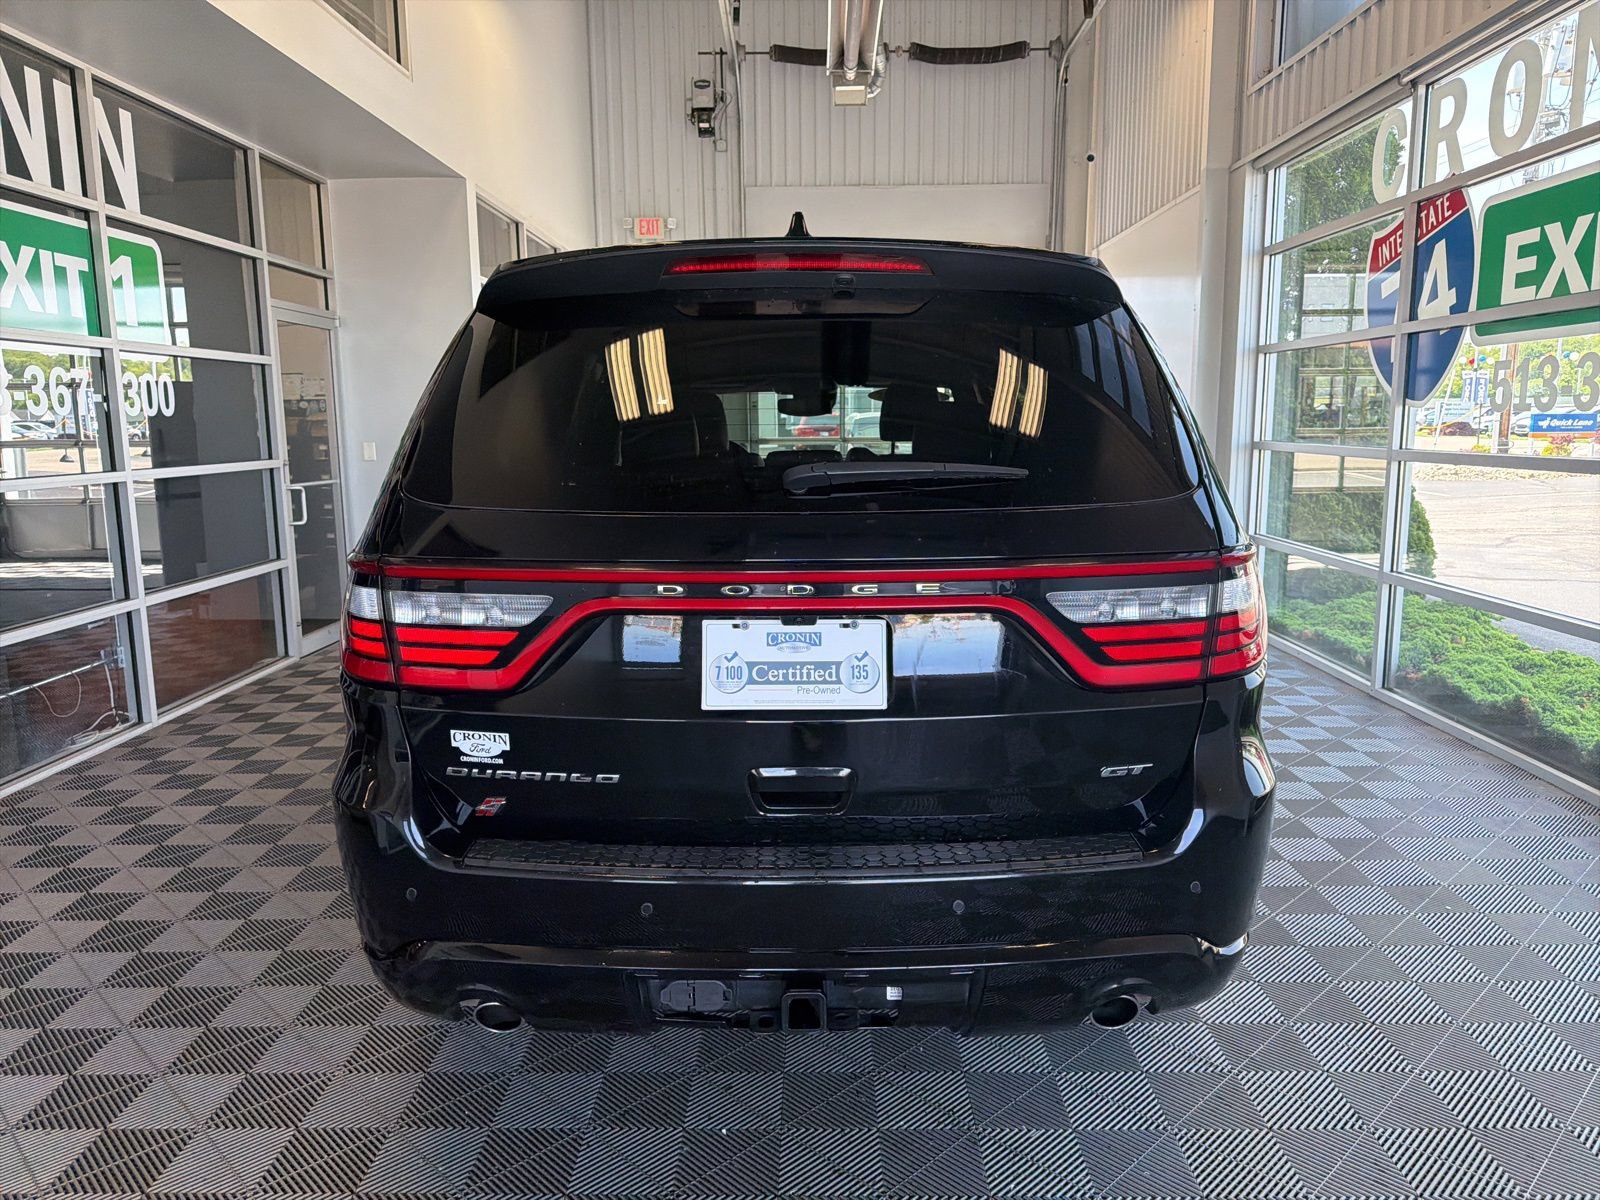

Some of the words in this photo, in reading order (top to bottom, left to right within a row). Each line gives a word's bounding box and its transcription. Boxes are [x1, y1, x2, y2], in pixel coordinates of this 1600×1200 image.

[639, 219, 661, 236] EXIT
[1378, 192, 1453, 268] INTETATE
[0, 240, 88, 319] XIT
[110, 255, 139, 327] 1
[1550, 418, 1573, 427] Quick
[1573, 418, 1594, 426] Lane
[657, 583, 941, 597] DODGE
[768, 633, 820, 645] CRONIN
[715, 665, 721, 680] 7
[725, 665, 742, 680] 100
[751, 664, 837, 681] Certified
[851, 664, 869, 680] 135
[797, 685, 841, 695] Pre-Owned
[453, 731, 507, 746] CRONIN
[469, 742, 491, 754] Ford
[460, 756, 503, 764] CRONINFORD.COM
[446, 767, 621, 784] DURANGO
[1100, 763, 1153, 778] GT
